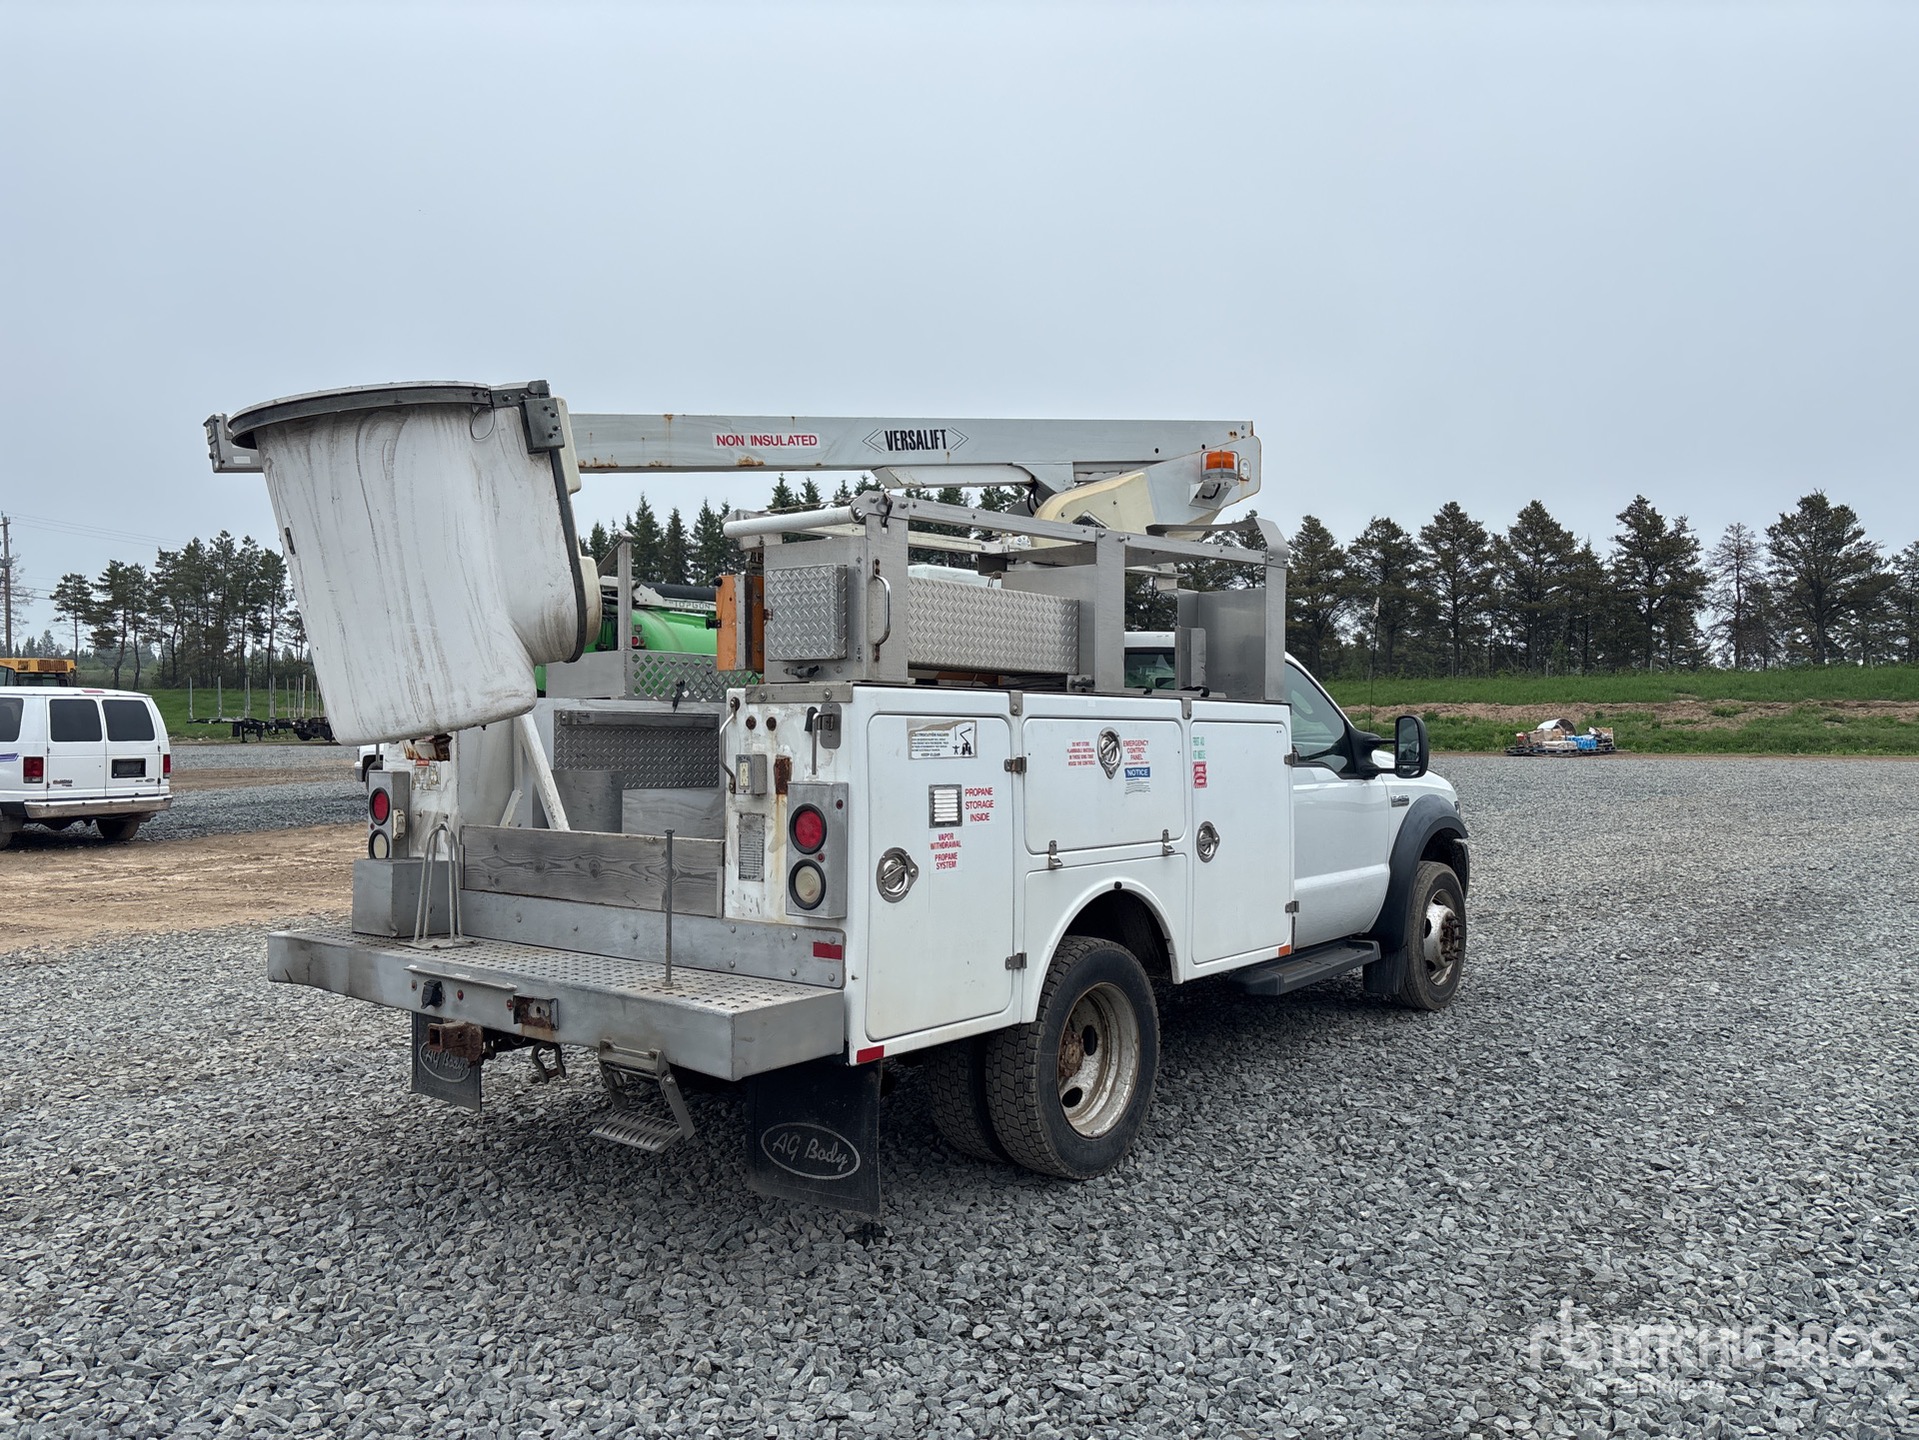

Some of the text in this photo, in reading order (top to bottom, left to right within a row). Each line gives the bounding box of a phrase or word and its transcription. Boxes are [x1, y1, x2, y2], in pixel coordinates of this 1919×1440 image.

[716, 434, 818, 447] NON INSULATED
[885, 429, 948, 451] VERSALIFT
[965, 787, 993, 797] PROPANE
[965, 800, 994, 810] STORAGE
[970, 813, 990, 822] INSIDE
[938, 832, 954, 841] VAPOR
[930, 841, 962, 850] WITHDRAWAL
[935, 852, 958, 861] PROPANE
[936, 861, 957, 870] SYSTEM
[772, 1132, 849, 1172] AG Body
